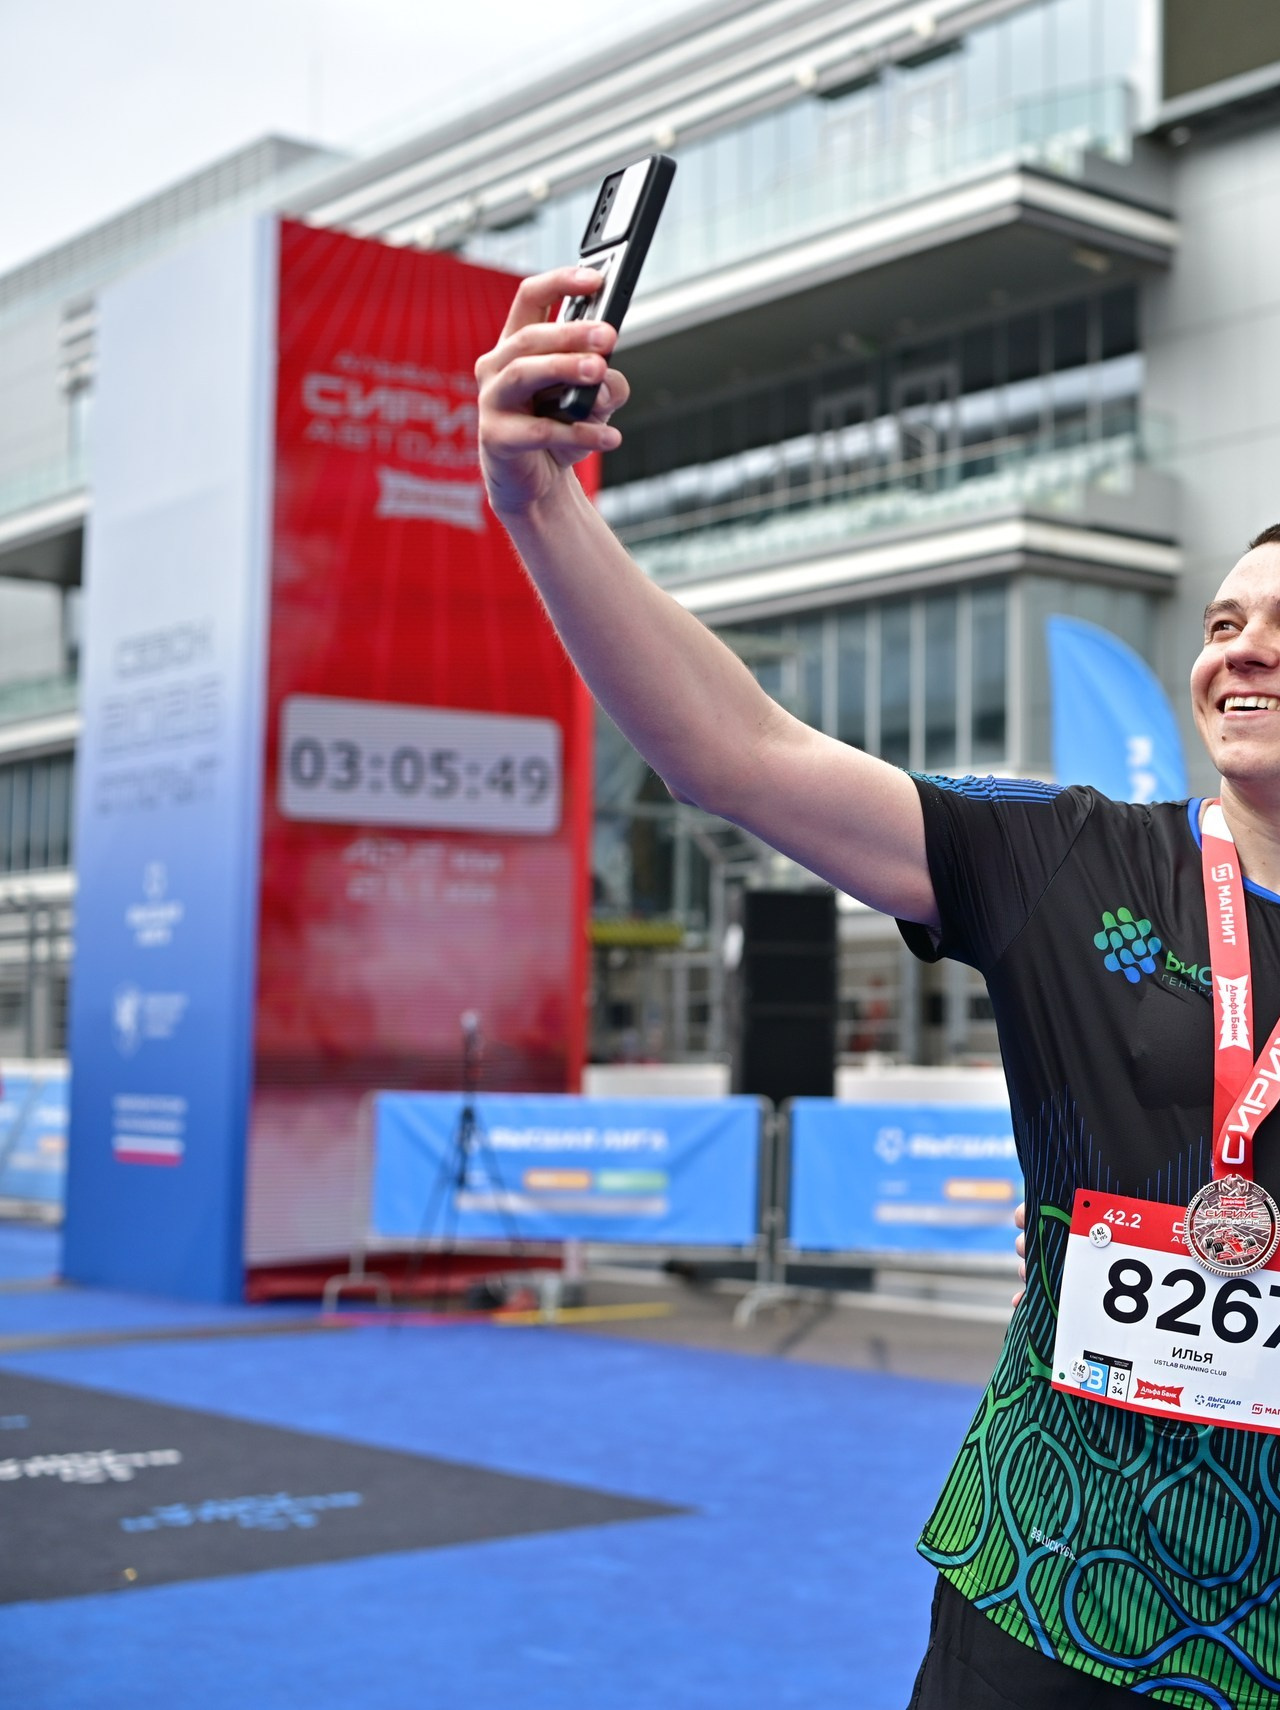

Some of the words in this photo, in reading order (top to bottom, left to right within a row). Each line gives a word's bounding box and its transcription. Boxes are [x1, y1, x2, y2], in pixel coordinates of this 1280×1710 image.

[289, 738, 551, 801] 03:05:49
[1218, 885, 1236, 946] МАГНИТ
[1227, 985, 1239, 1015] Альфа
[1231, 1017, 1240, 1041] Банк
[1103, 1209, 1142, 1229] 42.2
[1206, 1209, 1259, 1219] СИРИУС
[1096, 1226, 1105, 1236] 42
[1171, 1347, 1214, 1365] ИЛЬЯ
[1077, 1364, 1086, 1374] 42
[1154, 1359, 1179, 1369] USTLAB
[1179, 1363, 1209, 1374] RUNNING
[1210, 1369, 1228, 1377] CLUB
[1113, 1371, 1126, 1382] 30
[1111, 1386, 1123, 1396] 34
[1140, 1386, 1161, 1396] Альфа
[1161, 1389, 1178, 1399] Банк
[1207, 1396, 1242, 1406] ВЫСШАЯ
